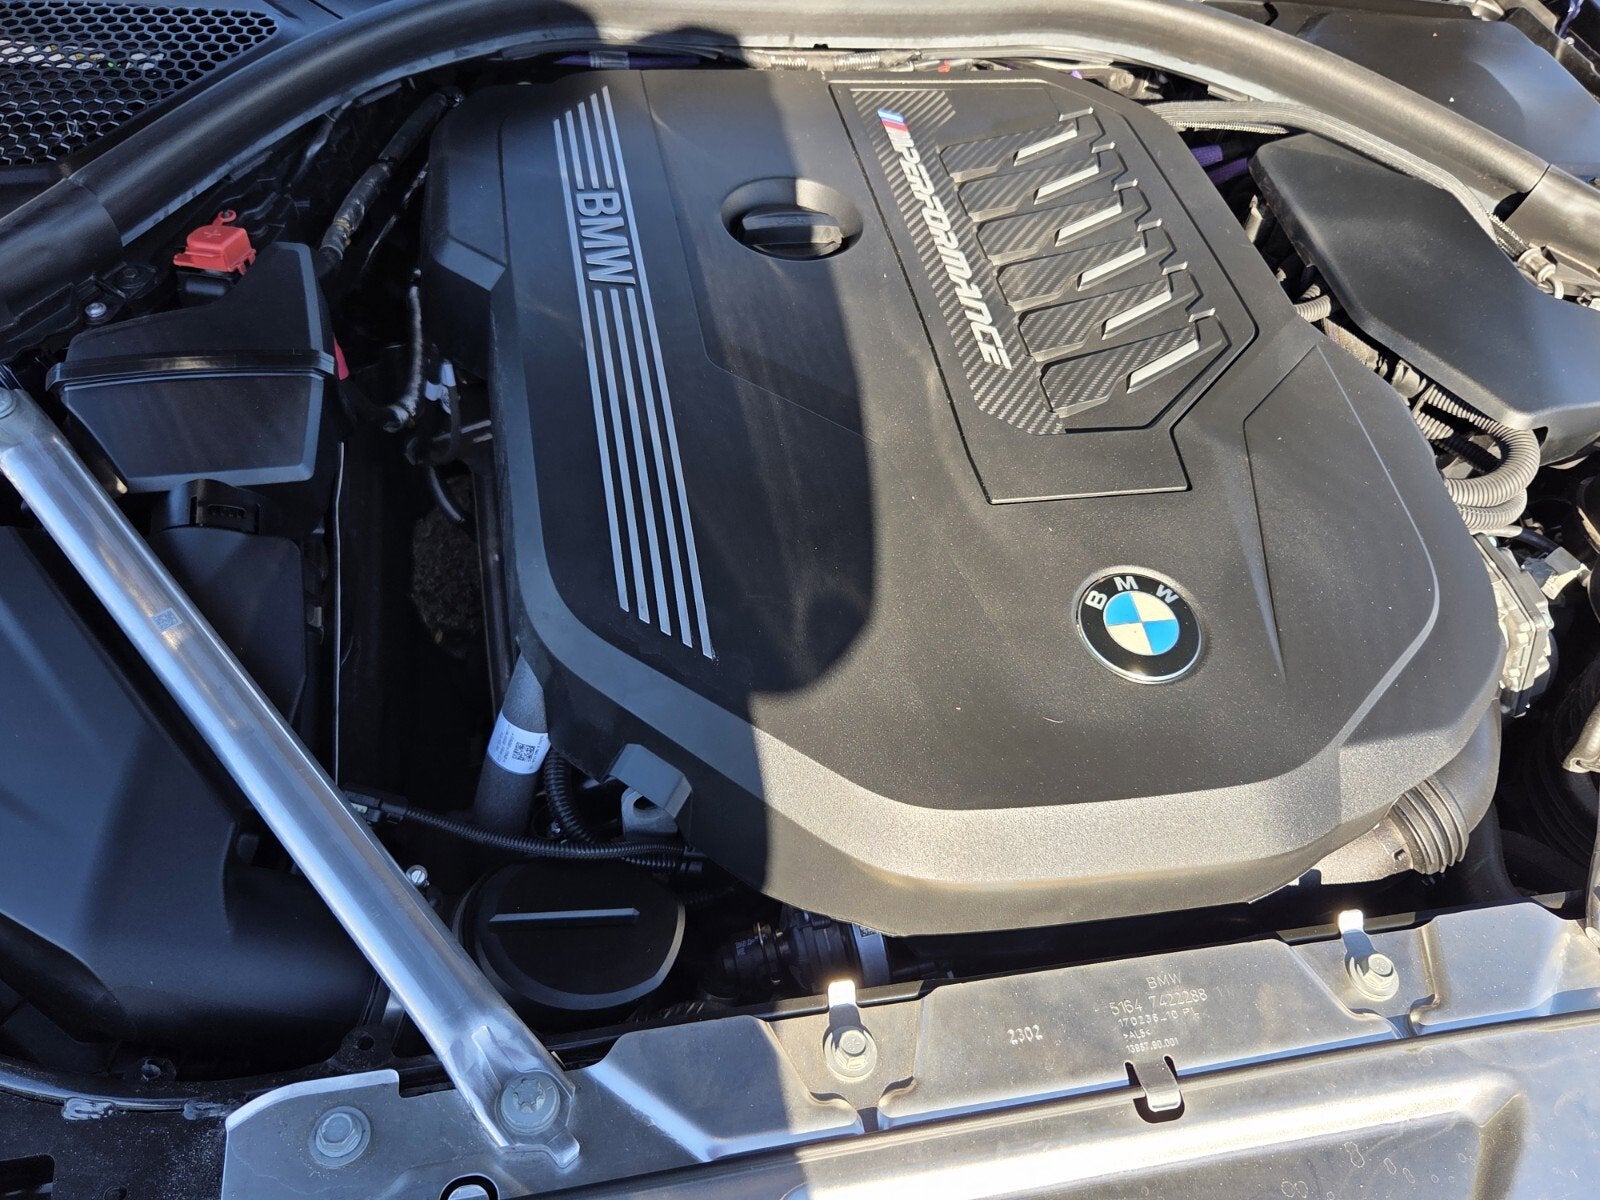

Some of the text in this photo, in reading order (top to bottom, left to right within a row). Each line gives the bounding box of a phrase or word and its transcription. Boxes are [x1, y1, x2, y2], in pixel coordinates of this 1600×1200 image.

[576, 192, 636, 285] BMW
[898, 146, 1013, 371] PERFORMANCE
[1085, 575, 1180, 611] BMW
[1146, 972, 1182, 990] BMW
[1109, 999, 1143, 1016] 5164
[1148, 988, 1208, 1009] 7422288
[1007, 1024, 1043, 1046] 2302
